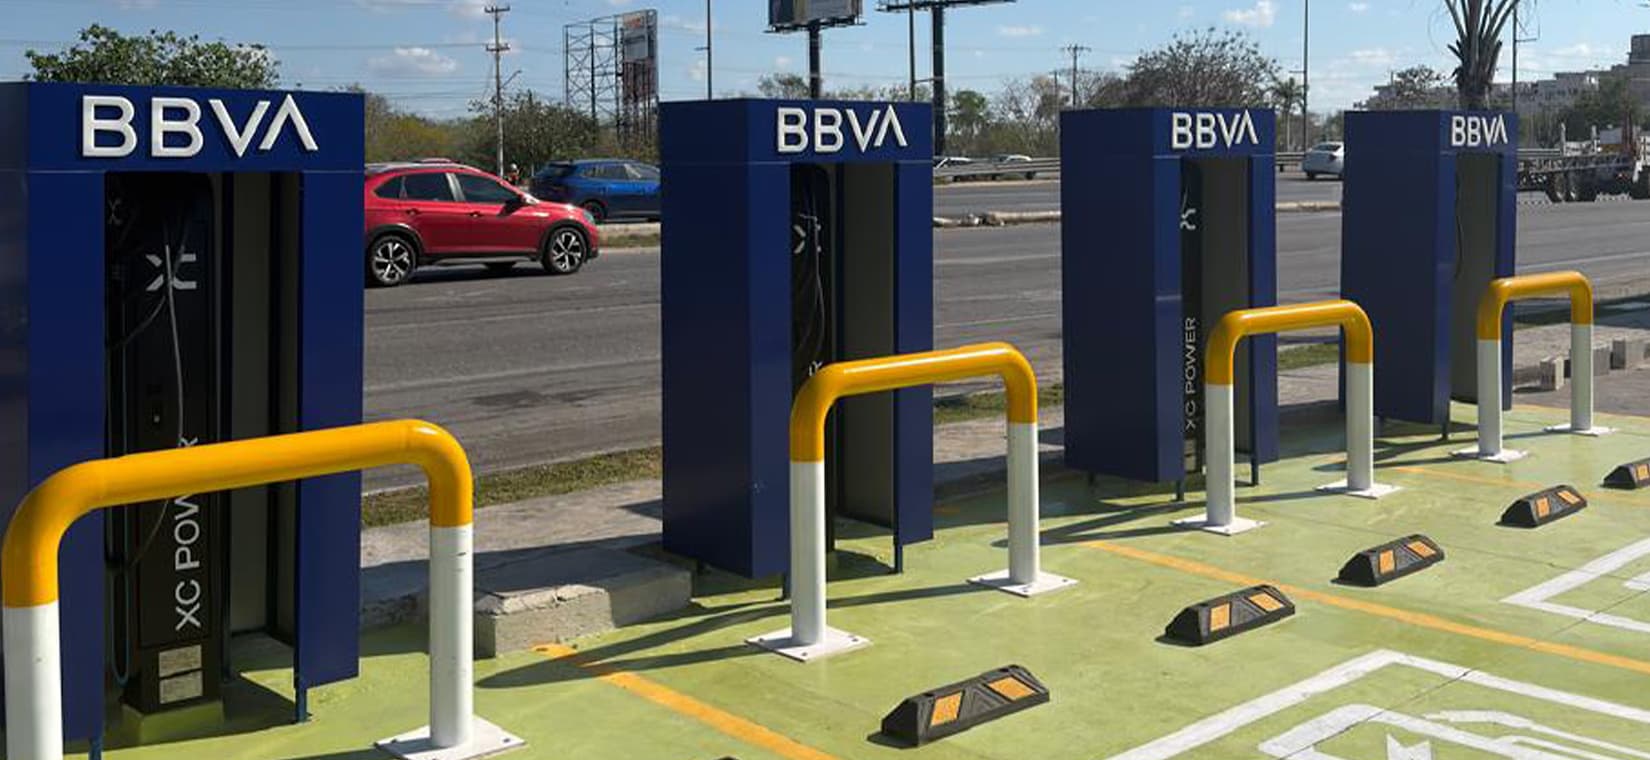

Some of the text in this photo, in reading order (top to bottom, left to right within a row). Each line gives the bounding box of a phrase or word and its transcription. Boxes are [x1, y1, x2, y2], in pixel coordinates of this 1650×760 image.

[82, 93, 318, 158] BBVA
[776, 104, 908, 153] BBVA
[1171, 109, 1259, 149] BBVA
[1451, 115, 1508, 147] BBVA
[1184, 316, 1197, 431] XC POWER
[174, 579, 201, 631] XC
